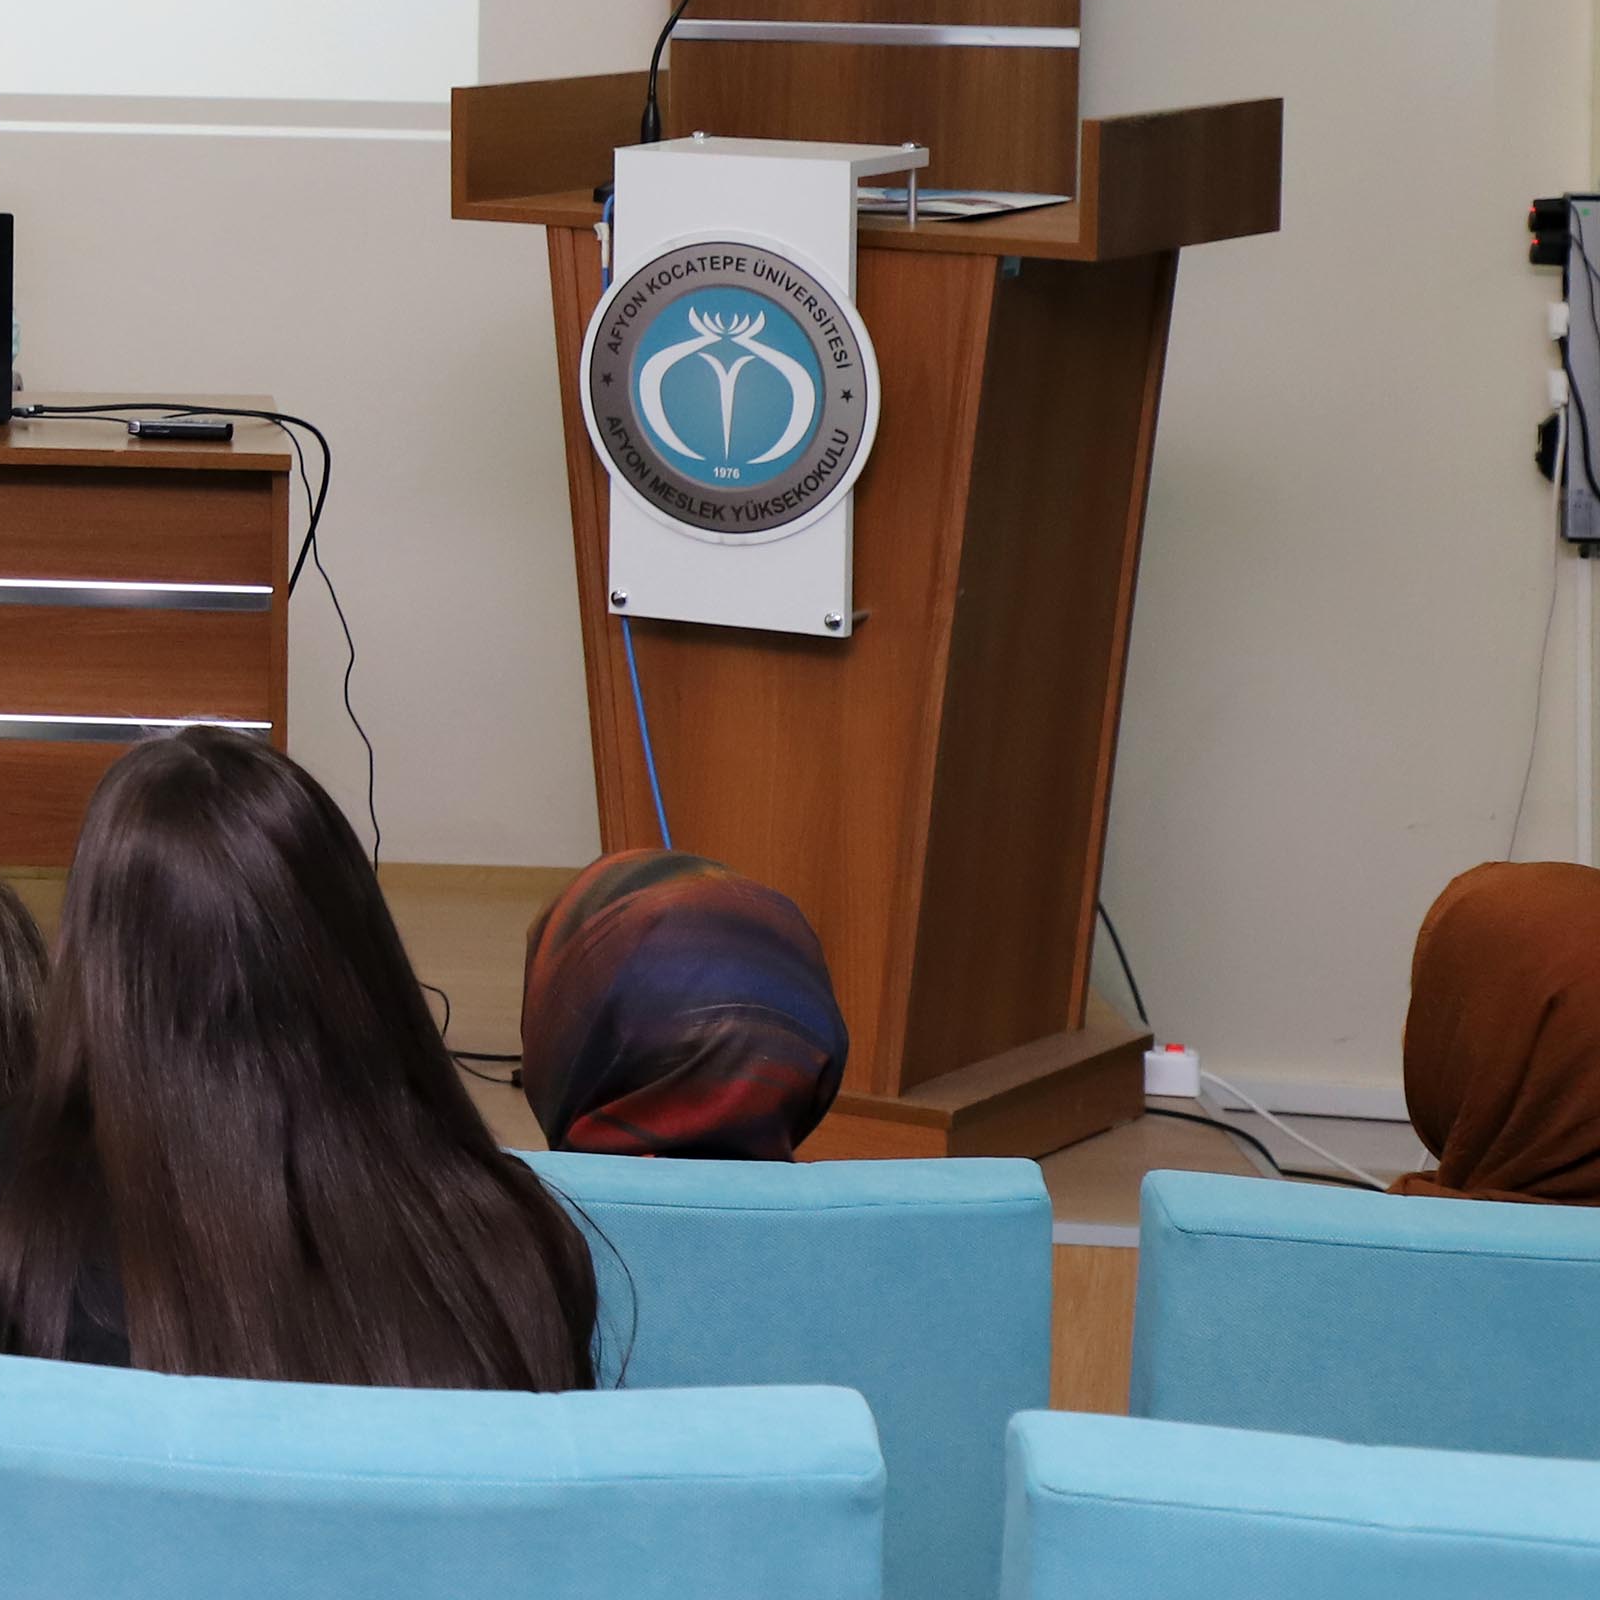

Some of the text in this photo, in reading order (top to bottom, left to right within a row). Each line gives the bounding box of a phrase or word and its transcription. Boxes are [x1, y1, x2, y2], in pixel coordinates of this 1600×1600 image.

[607, 255, 853, 369] AFYON KOCATEPE ÜNİVERSİTESİ
[606, 415, 850, 523] AFYON MESLEK YÜKSEKOKULU
[713, 466, 741, 480] 1976
